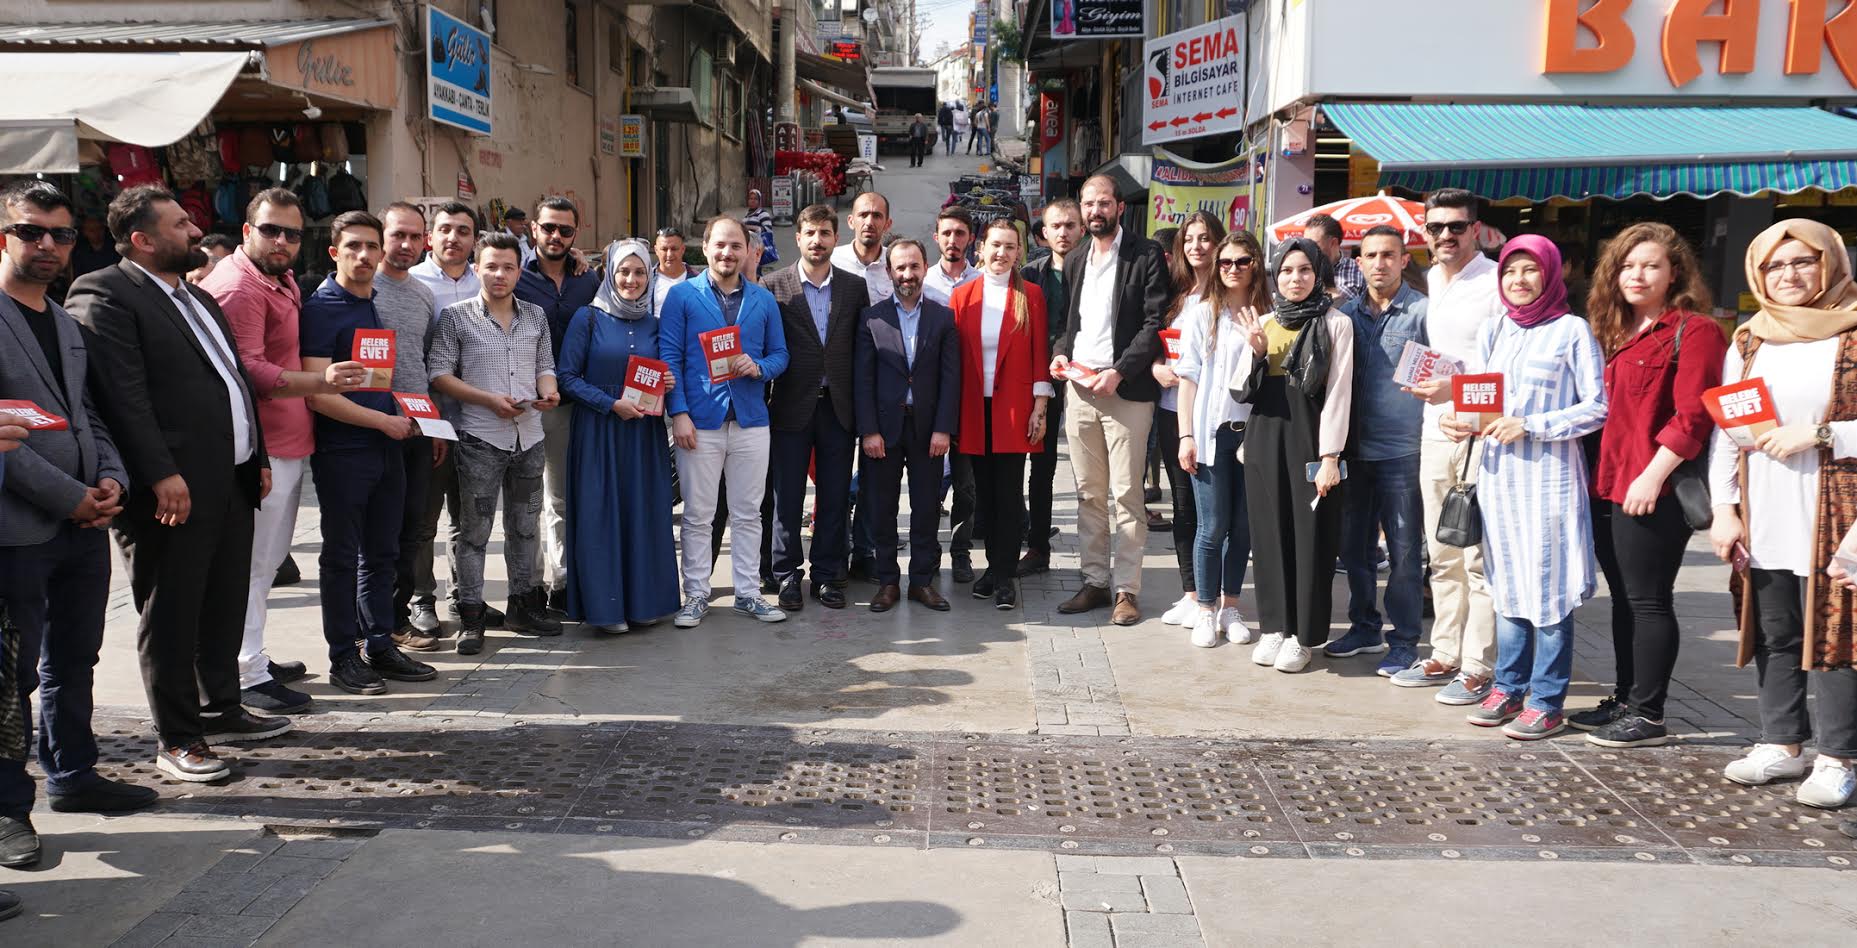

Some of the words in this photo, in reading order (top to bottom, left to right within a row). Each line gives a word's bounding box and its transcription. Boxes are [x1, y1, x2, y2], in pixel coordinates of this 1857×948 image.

[1079, 7, 1142, 24] Giyim
[1174, 28, 1238, 69] SEMA
[1174, 61, 1238, 88] BİLGİSAYAR
[434, 83, 456, 105] AYAKKABI
[1174, 86, 1213, 104] İNTERNET
[1216, 80, 1238, 96] CAFE
[1152, 98, 1168, 109] SEMA
[1046, 100, 1059, 138] avea
[1234, 208, 1246, 226] 90
[361, 338, 388, 346] NELERE
[712, 340, 734, 353] EVET
[360, 346, 389, 360] EVET
[634, 373, 660, 388] EVET
[1462, 392, 1497, 404] EVET
[406, 403, 432, 412] EVET
[1722, 397, 1762, 420] EVET
